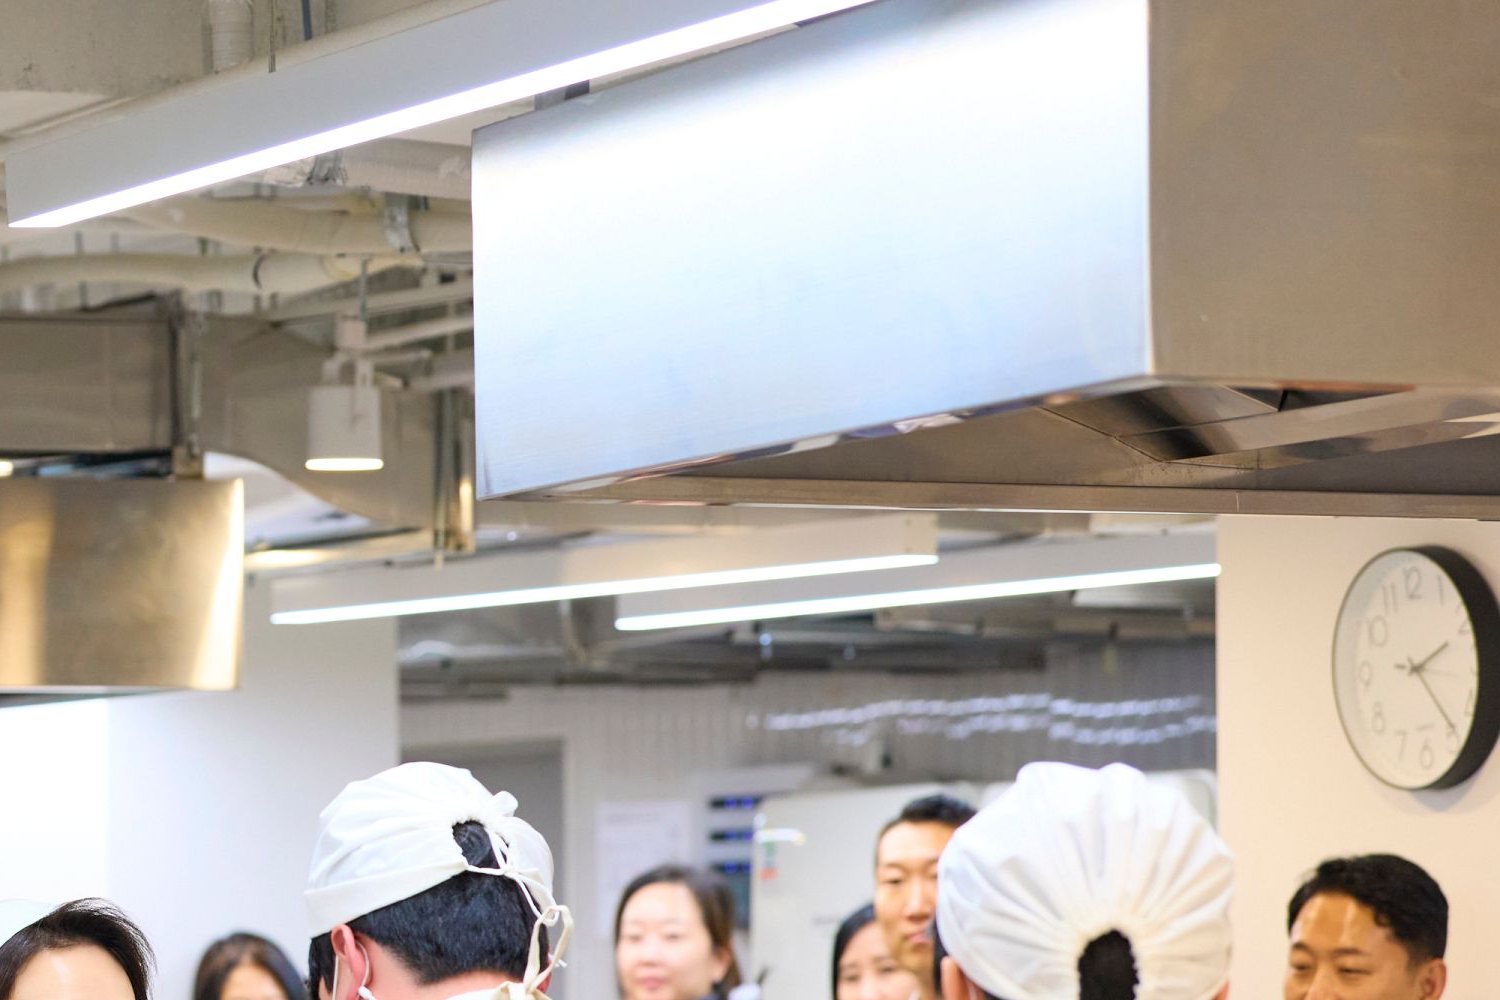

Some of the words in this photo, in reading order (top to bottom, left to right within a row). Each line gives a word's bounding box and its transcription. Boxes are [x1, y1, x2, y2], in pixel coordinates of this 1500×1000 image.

[1381, 582, 1399, 614] 11
[1402, 565, 1422, 601] 12
[1358, 660, 1373, 692] 9
[1371, 701, 1386, 735] 8
[1393, 729, 1409, 761] 7
[1419, 738, 1434, 770] 6
